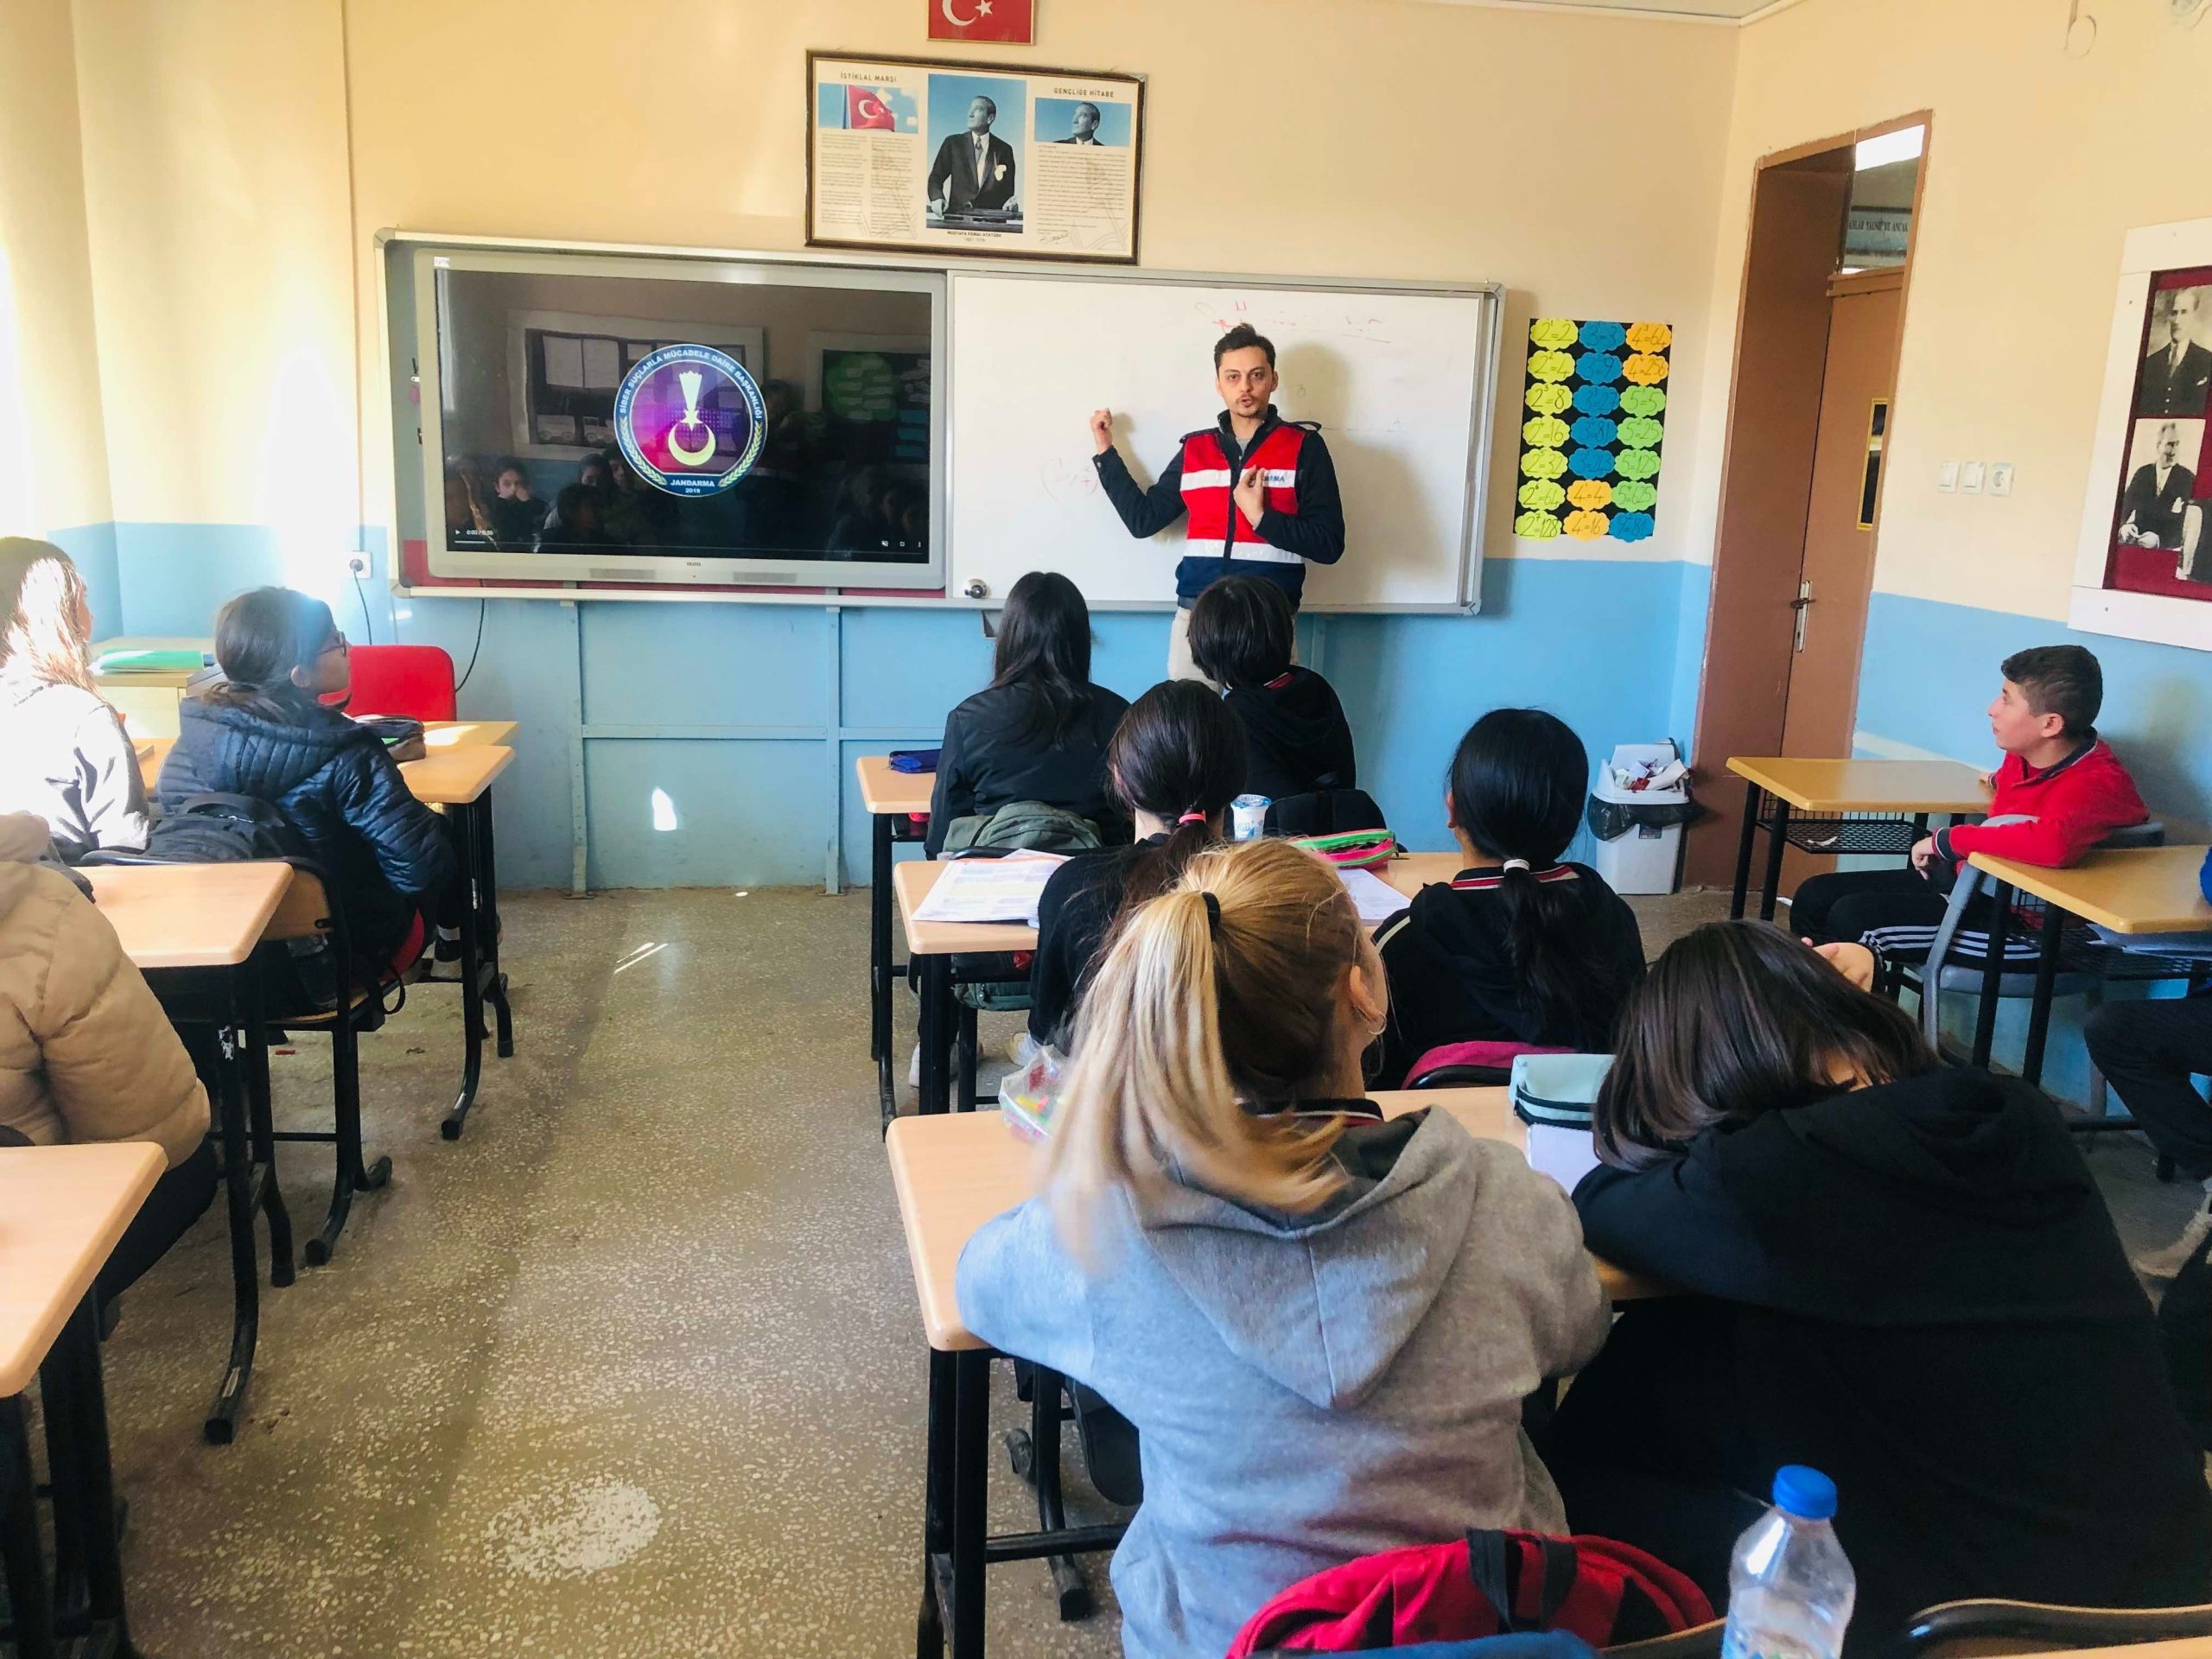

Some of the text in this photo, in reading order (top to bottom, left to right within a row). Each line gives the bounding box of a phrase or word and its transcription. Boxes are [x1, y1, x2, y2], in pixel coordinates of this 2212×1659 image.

[841, 71, 871, 81] İSTİKLAL
[1090, 89, 1114, 98] HİTABE
[620, 349, 762, 419] SİBER SUÇLARLA MÜCADELE DAİRE BAŞKANLIĞI
[671, 479, 715, 487] JANDARMA
